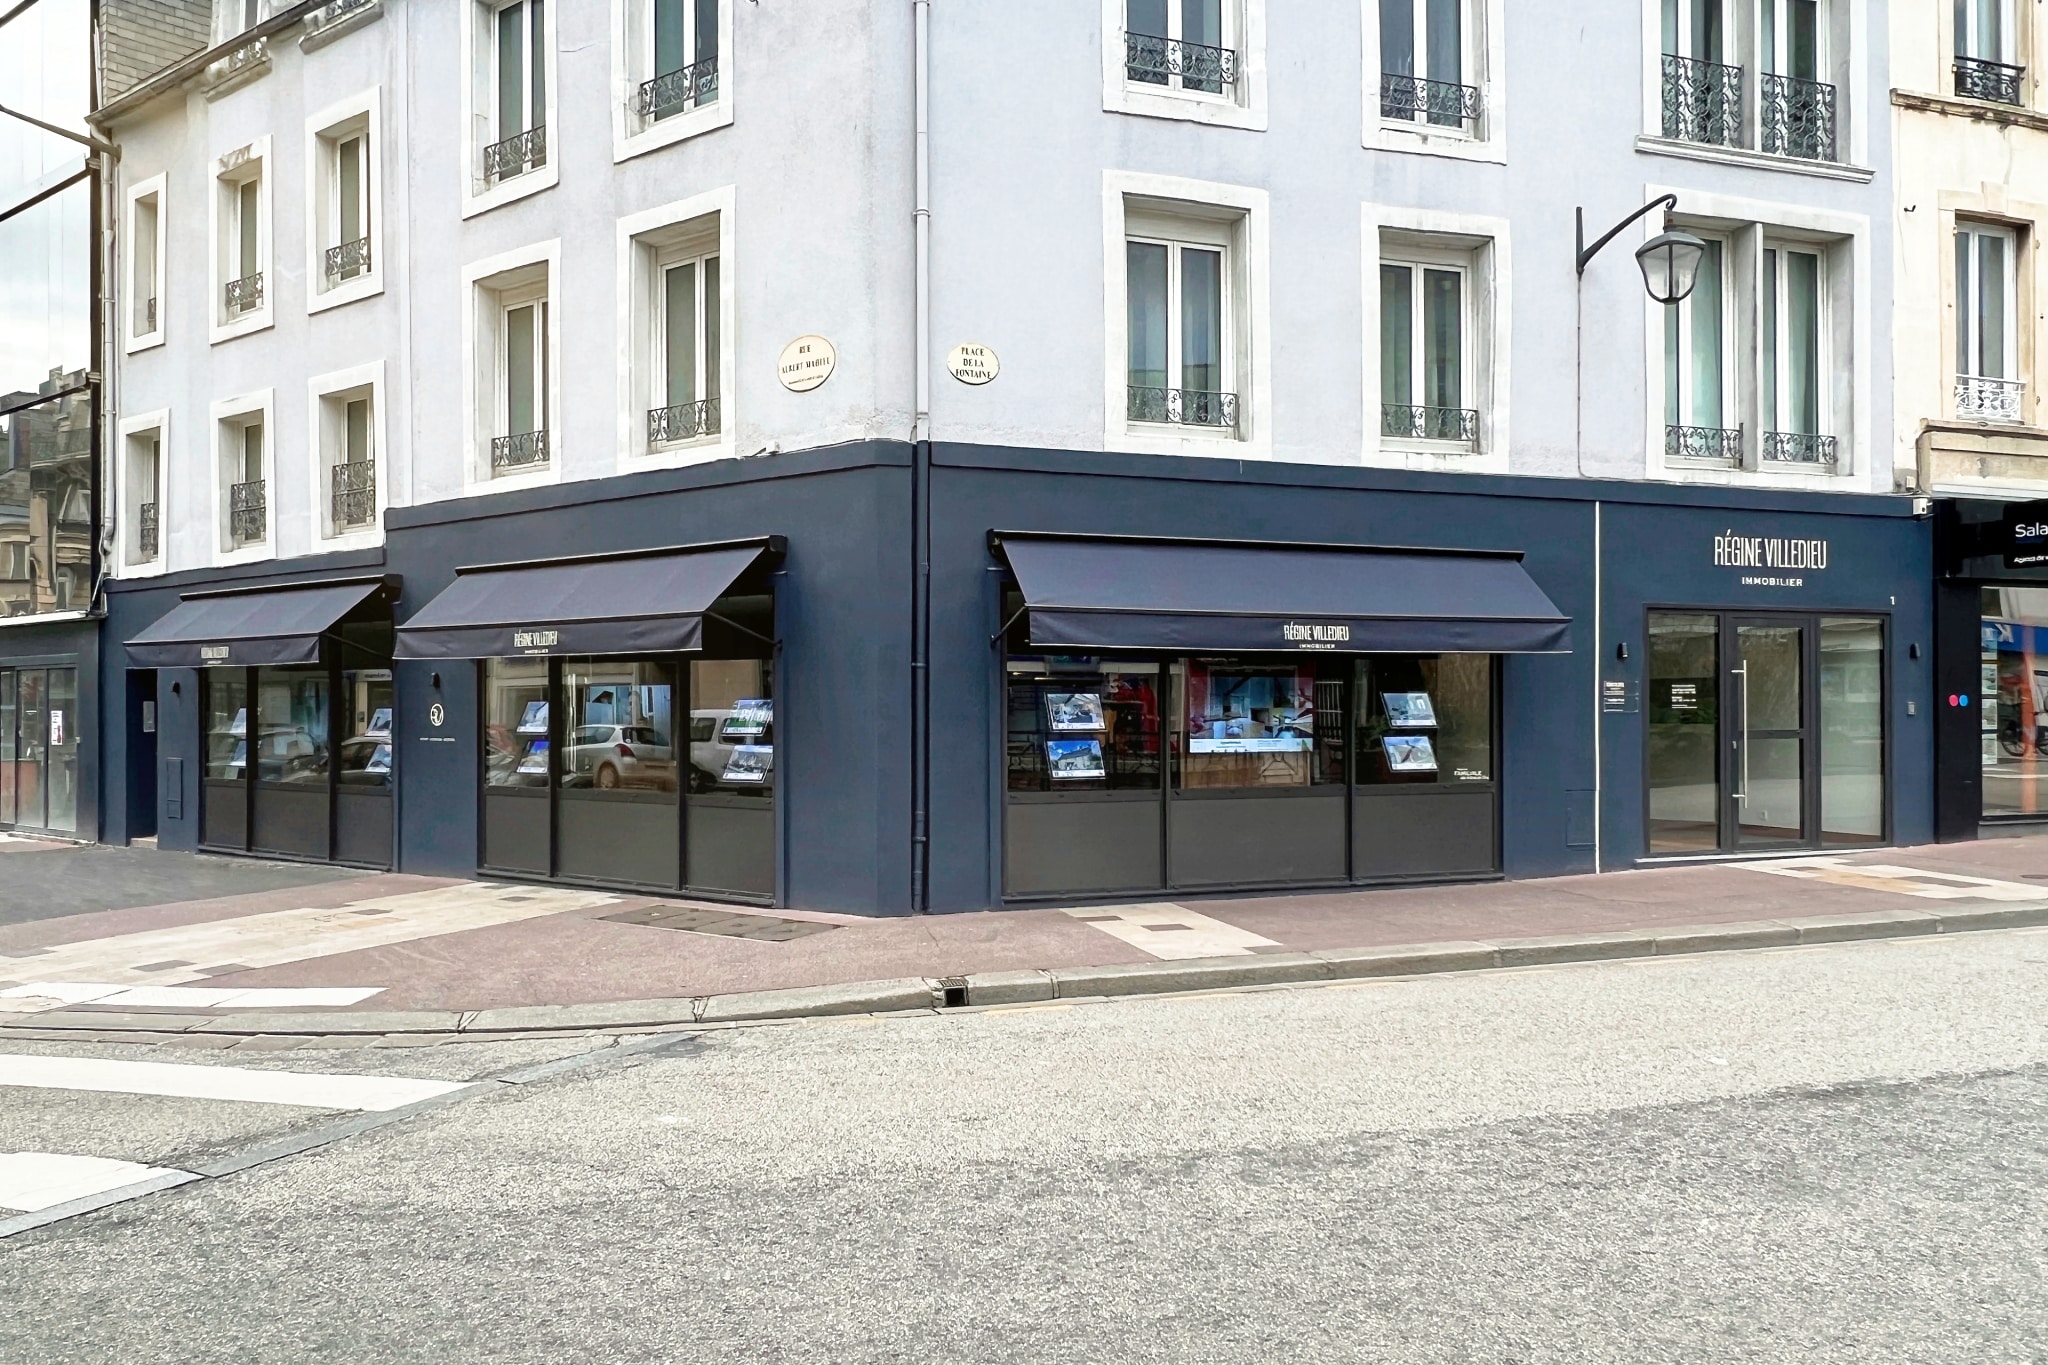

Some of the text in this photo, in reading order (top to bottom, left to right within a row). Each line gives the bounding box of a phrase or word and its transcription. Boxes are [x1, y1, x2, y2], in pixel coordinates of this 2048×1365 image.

[961, 346, 985, 356] PLACE
[963, 358, 985, 368] DE LA
[955, 368, 992, 380] FONTAINE
[1714, 529, 1827, 569] RÉGINE VILLEDIEU
[1741, 576, 1803, 587] IMMOBILIER
[1889, 595, 1896, 606] 1
[1283, 621, 1350, 641] RÉGINE VILLEDIEU
